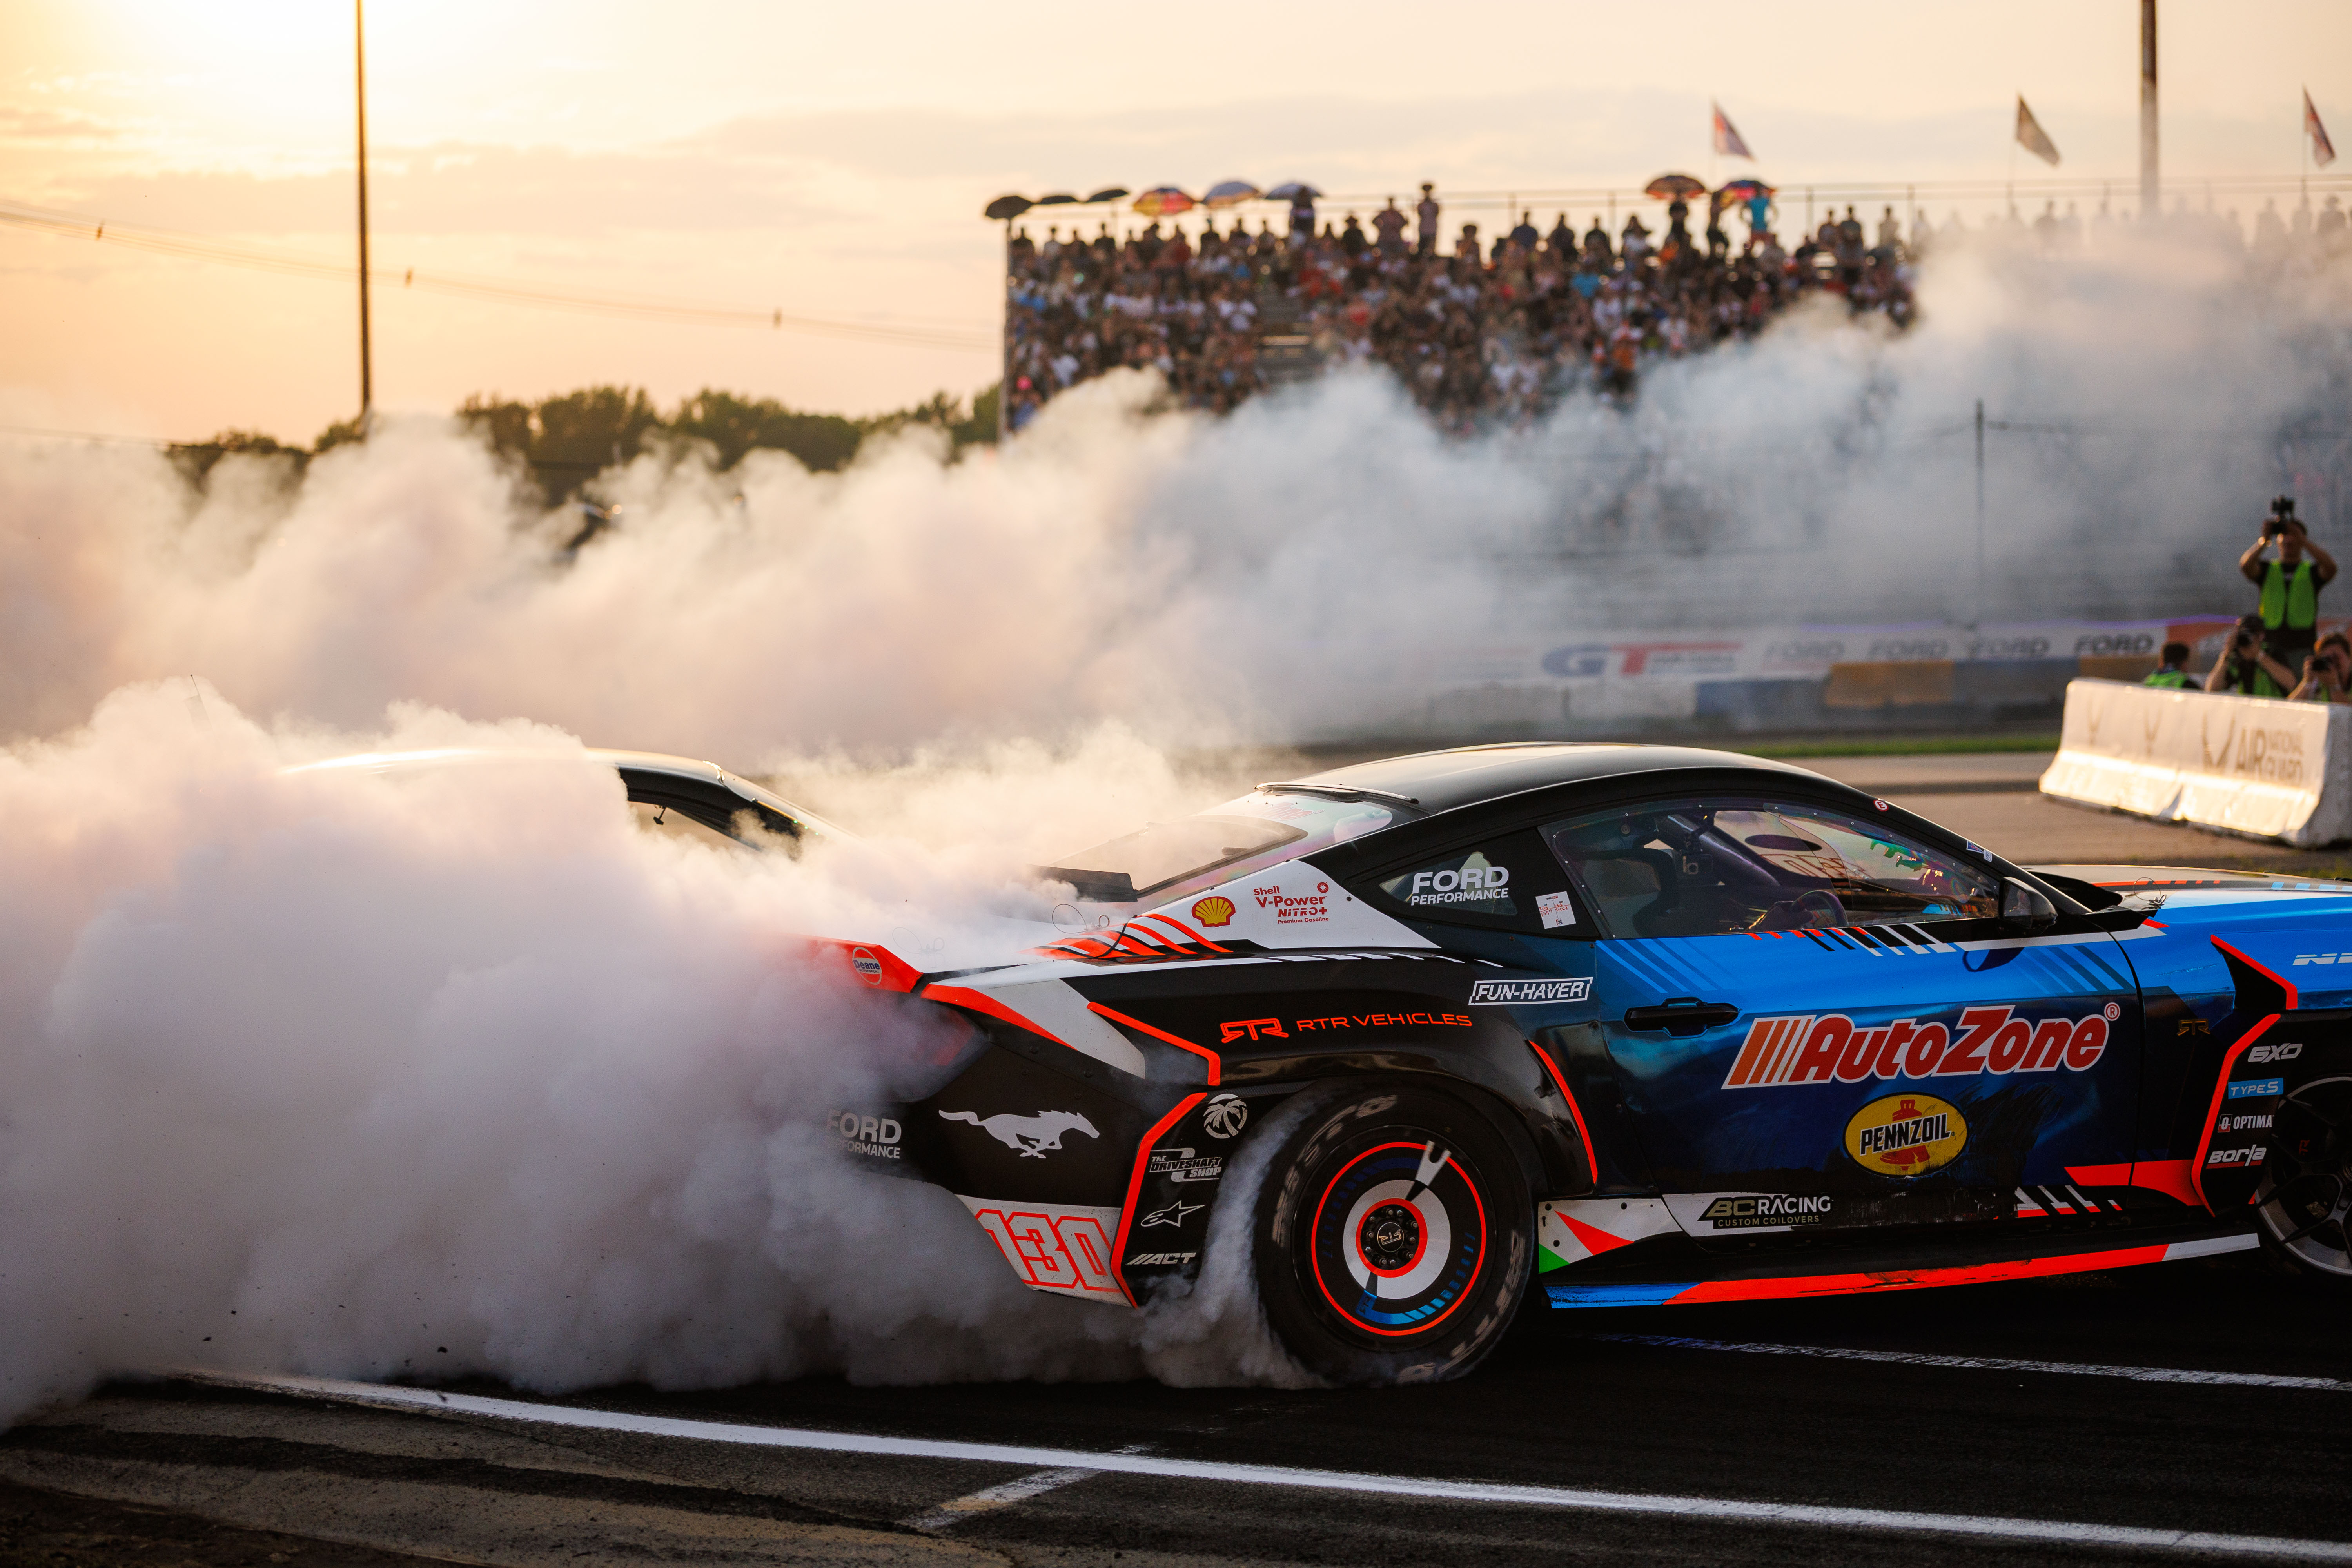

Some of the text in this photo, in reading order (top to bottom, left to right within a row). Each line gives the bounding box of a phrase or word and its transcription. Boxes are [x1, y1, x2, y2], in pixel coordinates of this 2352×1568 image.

[1868, 637, 1949, 660] FORD
[2074, 633, 2154, 655] FORD
[1412, 866, 1509, 894] FORD
[1253, 886, 1280, 895] Shell
[1411, 888, 1509, 906] PERFORMANCE
[1255, 896, 1327, 908] V-Power
[853, 960, 880, 970] Deane
[1475, 982, 1584, 1000] FUN-HAVER
[1296, 1017, 1350, 1031] RTR
[1352, 1013, 1472, 1026] VEHICLES
[827, 1109, 902, 1144] FORD
[2233, 1115, 2272, 1129] OPTIMA
[1860, 1112, 1952, 1156] PENNZOIL
[1149, 1157, 1222, 1172] DRIVESHAFT
[1189, 1167, 1222, 1178] SHOP
[1758, 1196, 1831, 1215] RACING
[1718, 1215, 1819, 1227] CUSTOM COILOVERS
[975, 1208, 1121, 1293] 130
